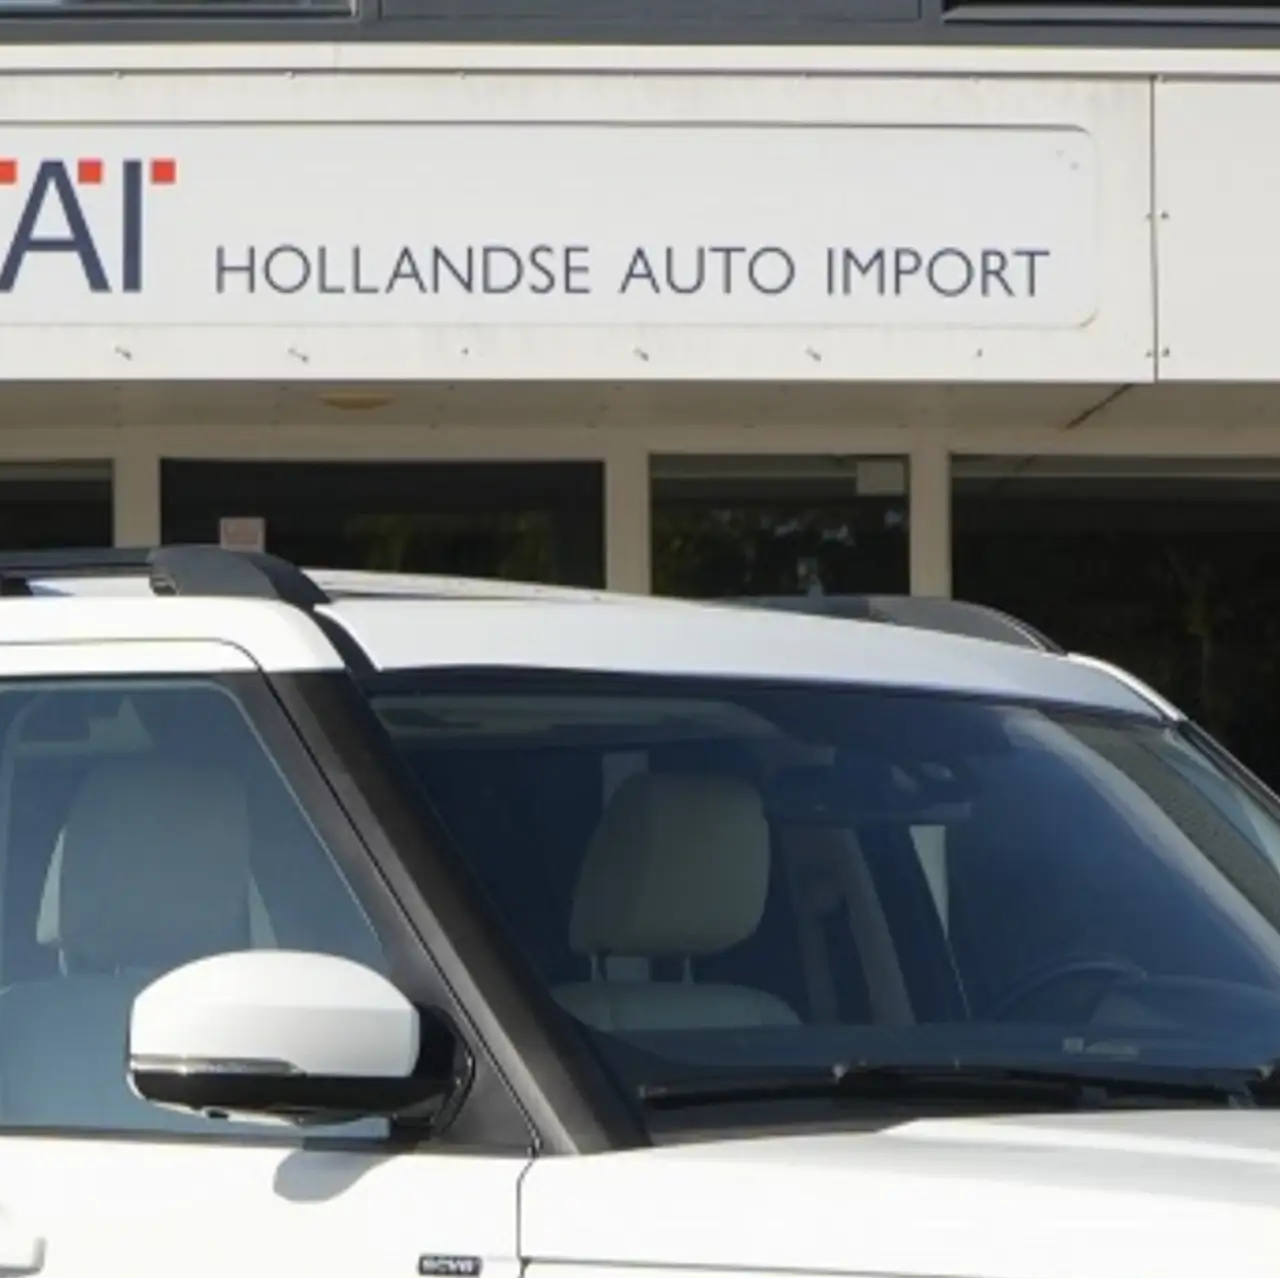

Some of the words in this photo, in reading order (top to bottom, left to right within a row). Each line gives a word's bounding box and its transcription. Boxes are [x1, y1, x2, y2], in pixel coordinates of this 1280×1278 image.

[215, 244, 591, 295] HOLLANDSE
[619, 246, 797, 296] AUTO
[825, 246, 1052, 298] IMPORT
